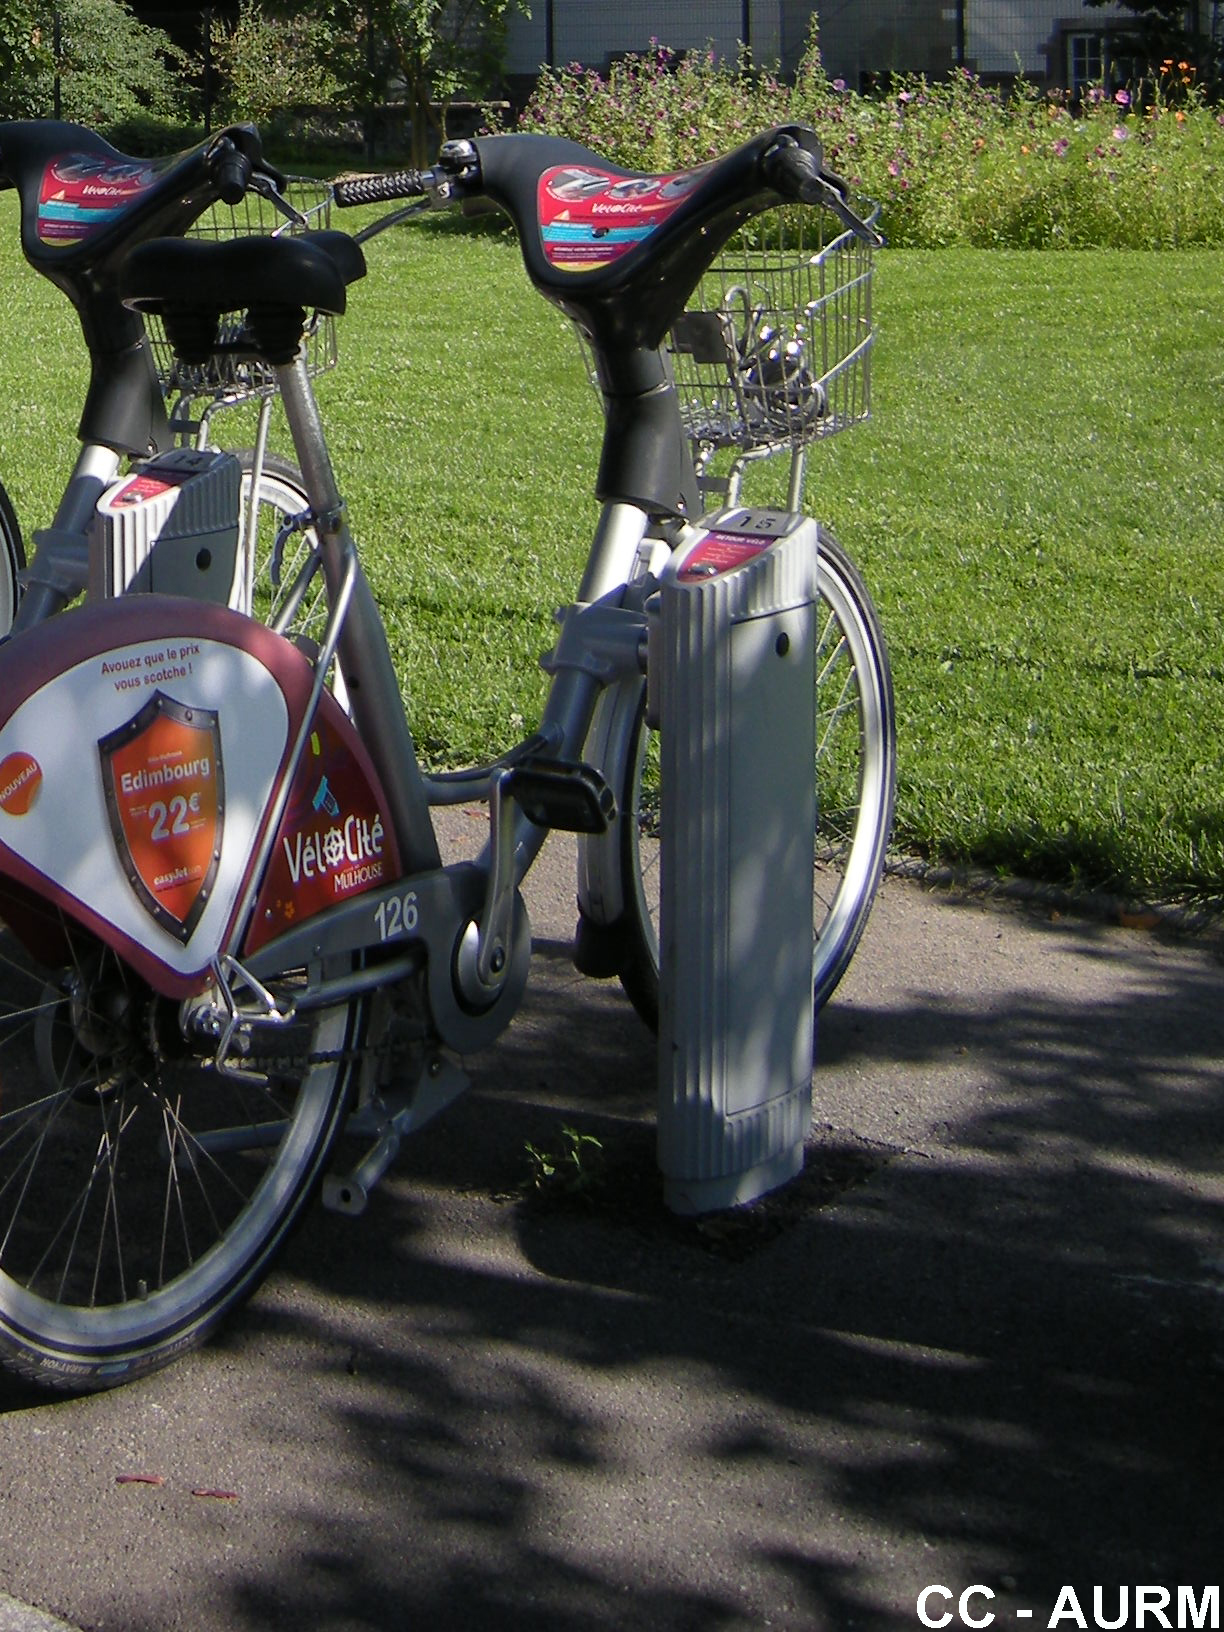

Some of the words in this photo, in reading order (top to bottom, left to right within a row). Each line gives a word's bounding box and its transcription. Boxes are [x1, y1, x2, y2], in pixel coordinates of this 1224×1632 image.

[740, 516, 776, 528] 15
[101, 658, 143, 676] Avouez
[145, 652, 165, 667] que
[167, 649, 177, 661] le
[180, 644, 200, 661] prix
[114, 677, 142, 692] vous
[144, 666, 187, 685] scotche
[120, 757, 210, 793] Edimbourg
[333, 862, 383, 894] MULHOUSE
[375, 891, 418, 941] 126
